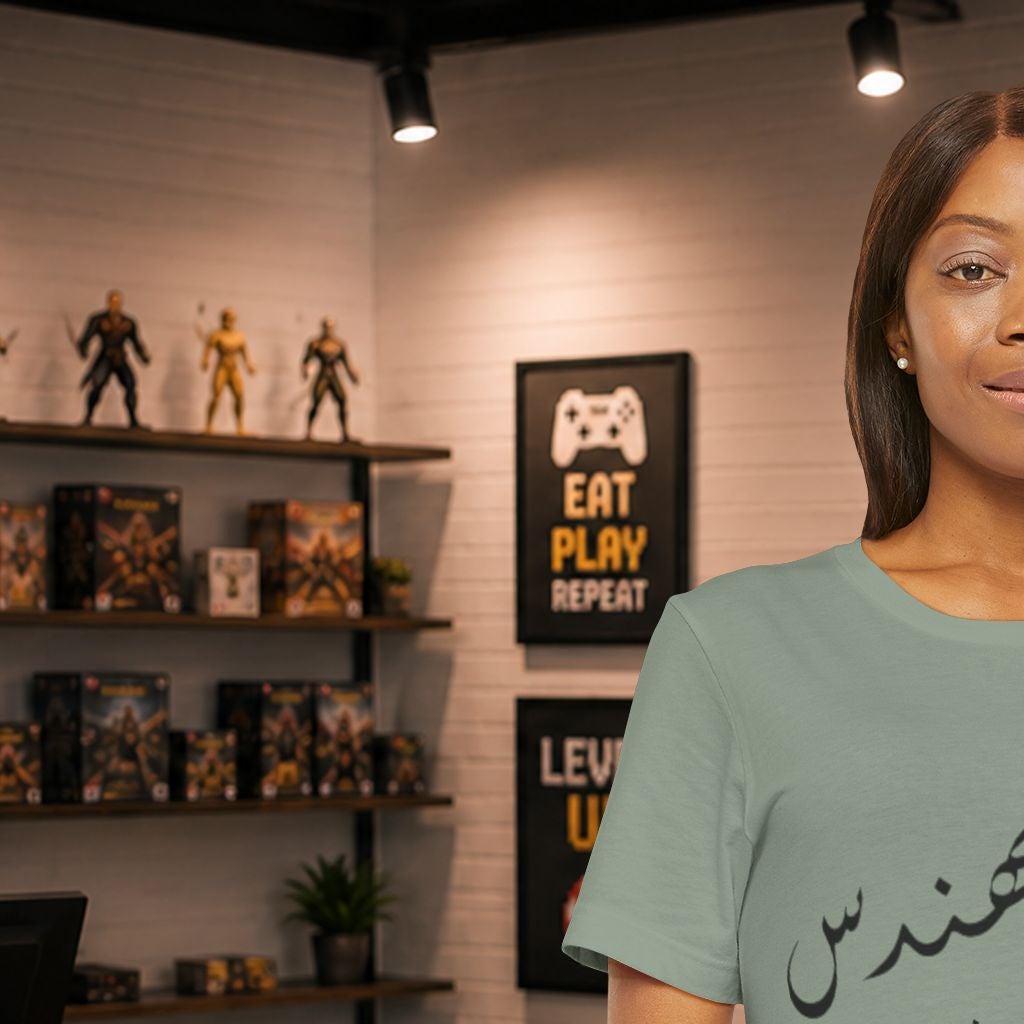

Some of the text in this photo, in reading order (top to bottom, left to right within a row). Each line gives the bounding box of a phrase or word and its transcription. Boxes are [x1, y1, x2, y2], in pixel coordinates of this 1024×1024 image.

[563, 472, 637, 519] EAT
[551, 526, 648, 573] PLAY
[551, 578, 648, 613] REPEAT
[567, 793, 610, 853] U
